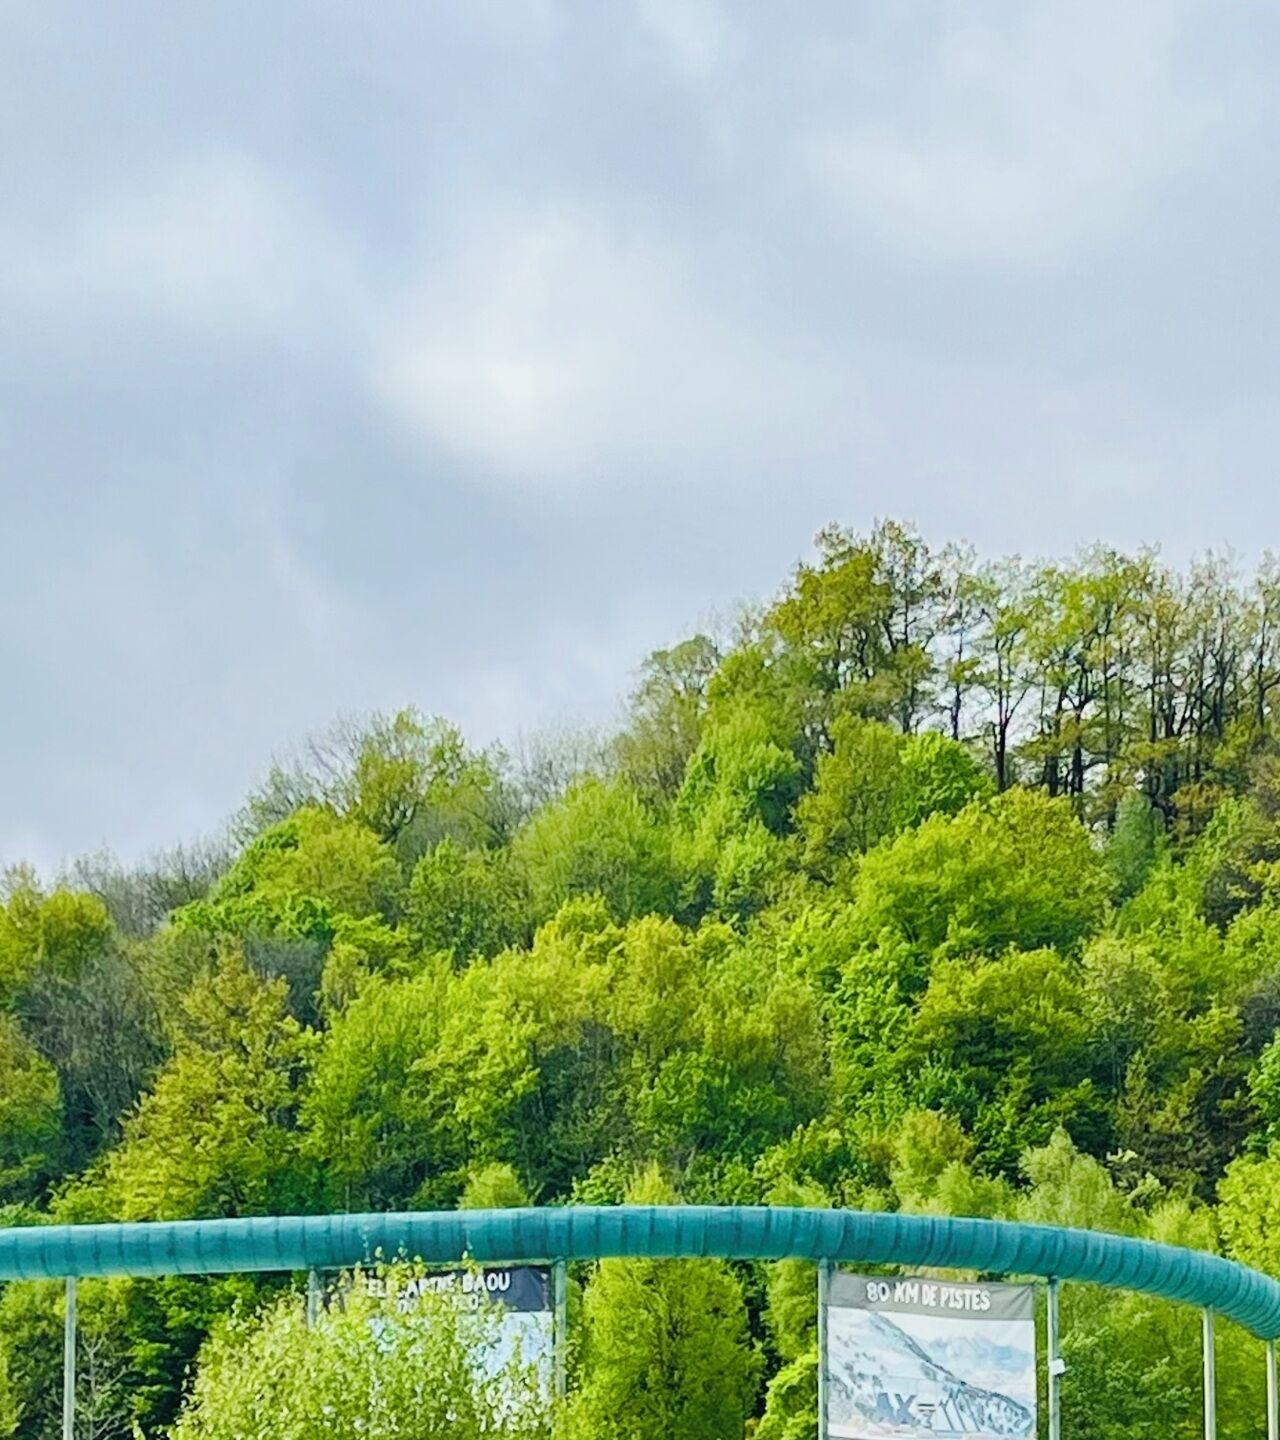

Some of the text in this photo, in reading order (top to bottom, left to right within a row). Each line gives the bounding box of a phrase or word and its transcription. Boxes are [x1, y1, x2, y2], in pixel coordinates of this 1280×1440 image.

[866, 1281, 992, 1312] 80 KM DE PISTES
